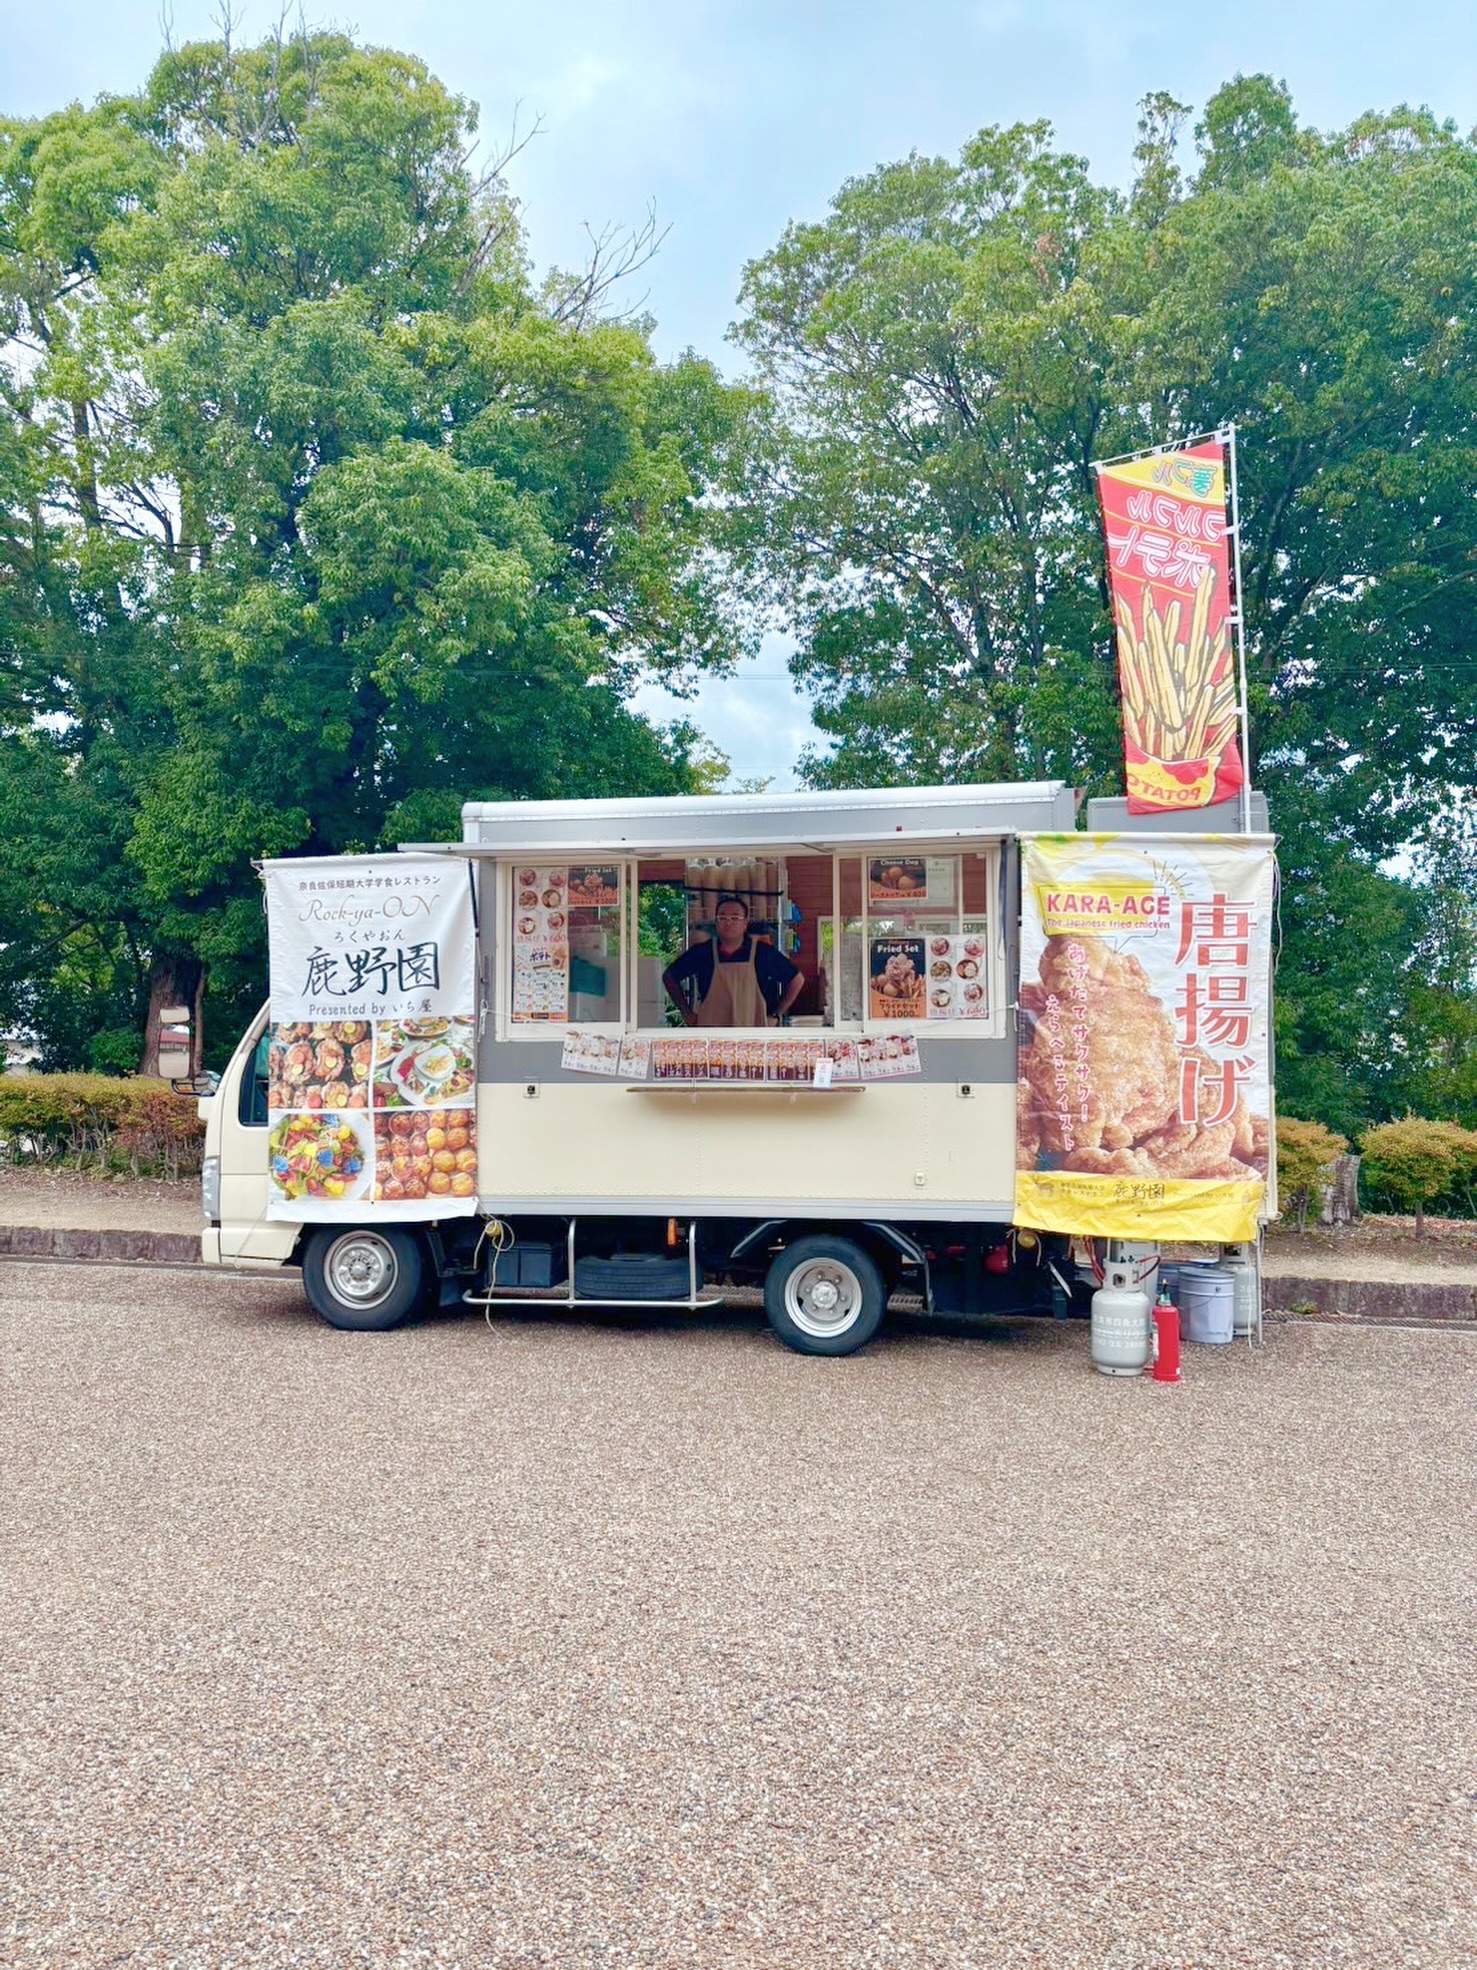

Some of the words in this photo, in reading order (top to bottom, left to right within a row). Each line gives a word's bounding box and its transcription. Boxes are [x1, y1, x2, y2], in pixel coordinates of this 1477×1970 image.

[299, 876, 441, 891] 奈良佐保短期大学学食レストラン
[299, 894, 440, 927] Rock-ya-ON
[1047, 894, 1170, 915] KARA-AGE
[1063, 919, 1106, 929] Japanese
[1109, 920, 1132, 929] fried
[1135, 920, 1170, 930] chicken
[334, 929, 405, 943] ろくやおん
[877, 945, 902, 953] Fried
[904, 945, 919, 953] Set
[301, 942, 439, 996] 鹿野園
[309, 1004, 366, 1015] Presented
[371, 1002, 386, 1014] by
[1174, 893, 1258, 1128] 唐揚げ
[1112, 1181, 1165, 1199] 鹿野園
